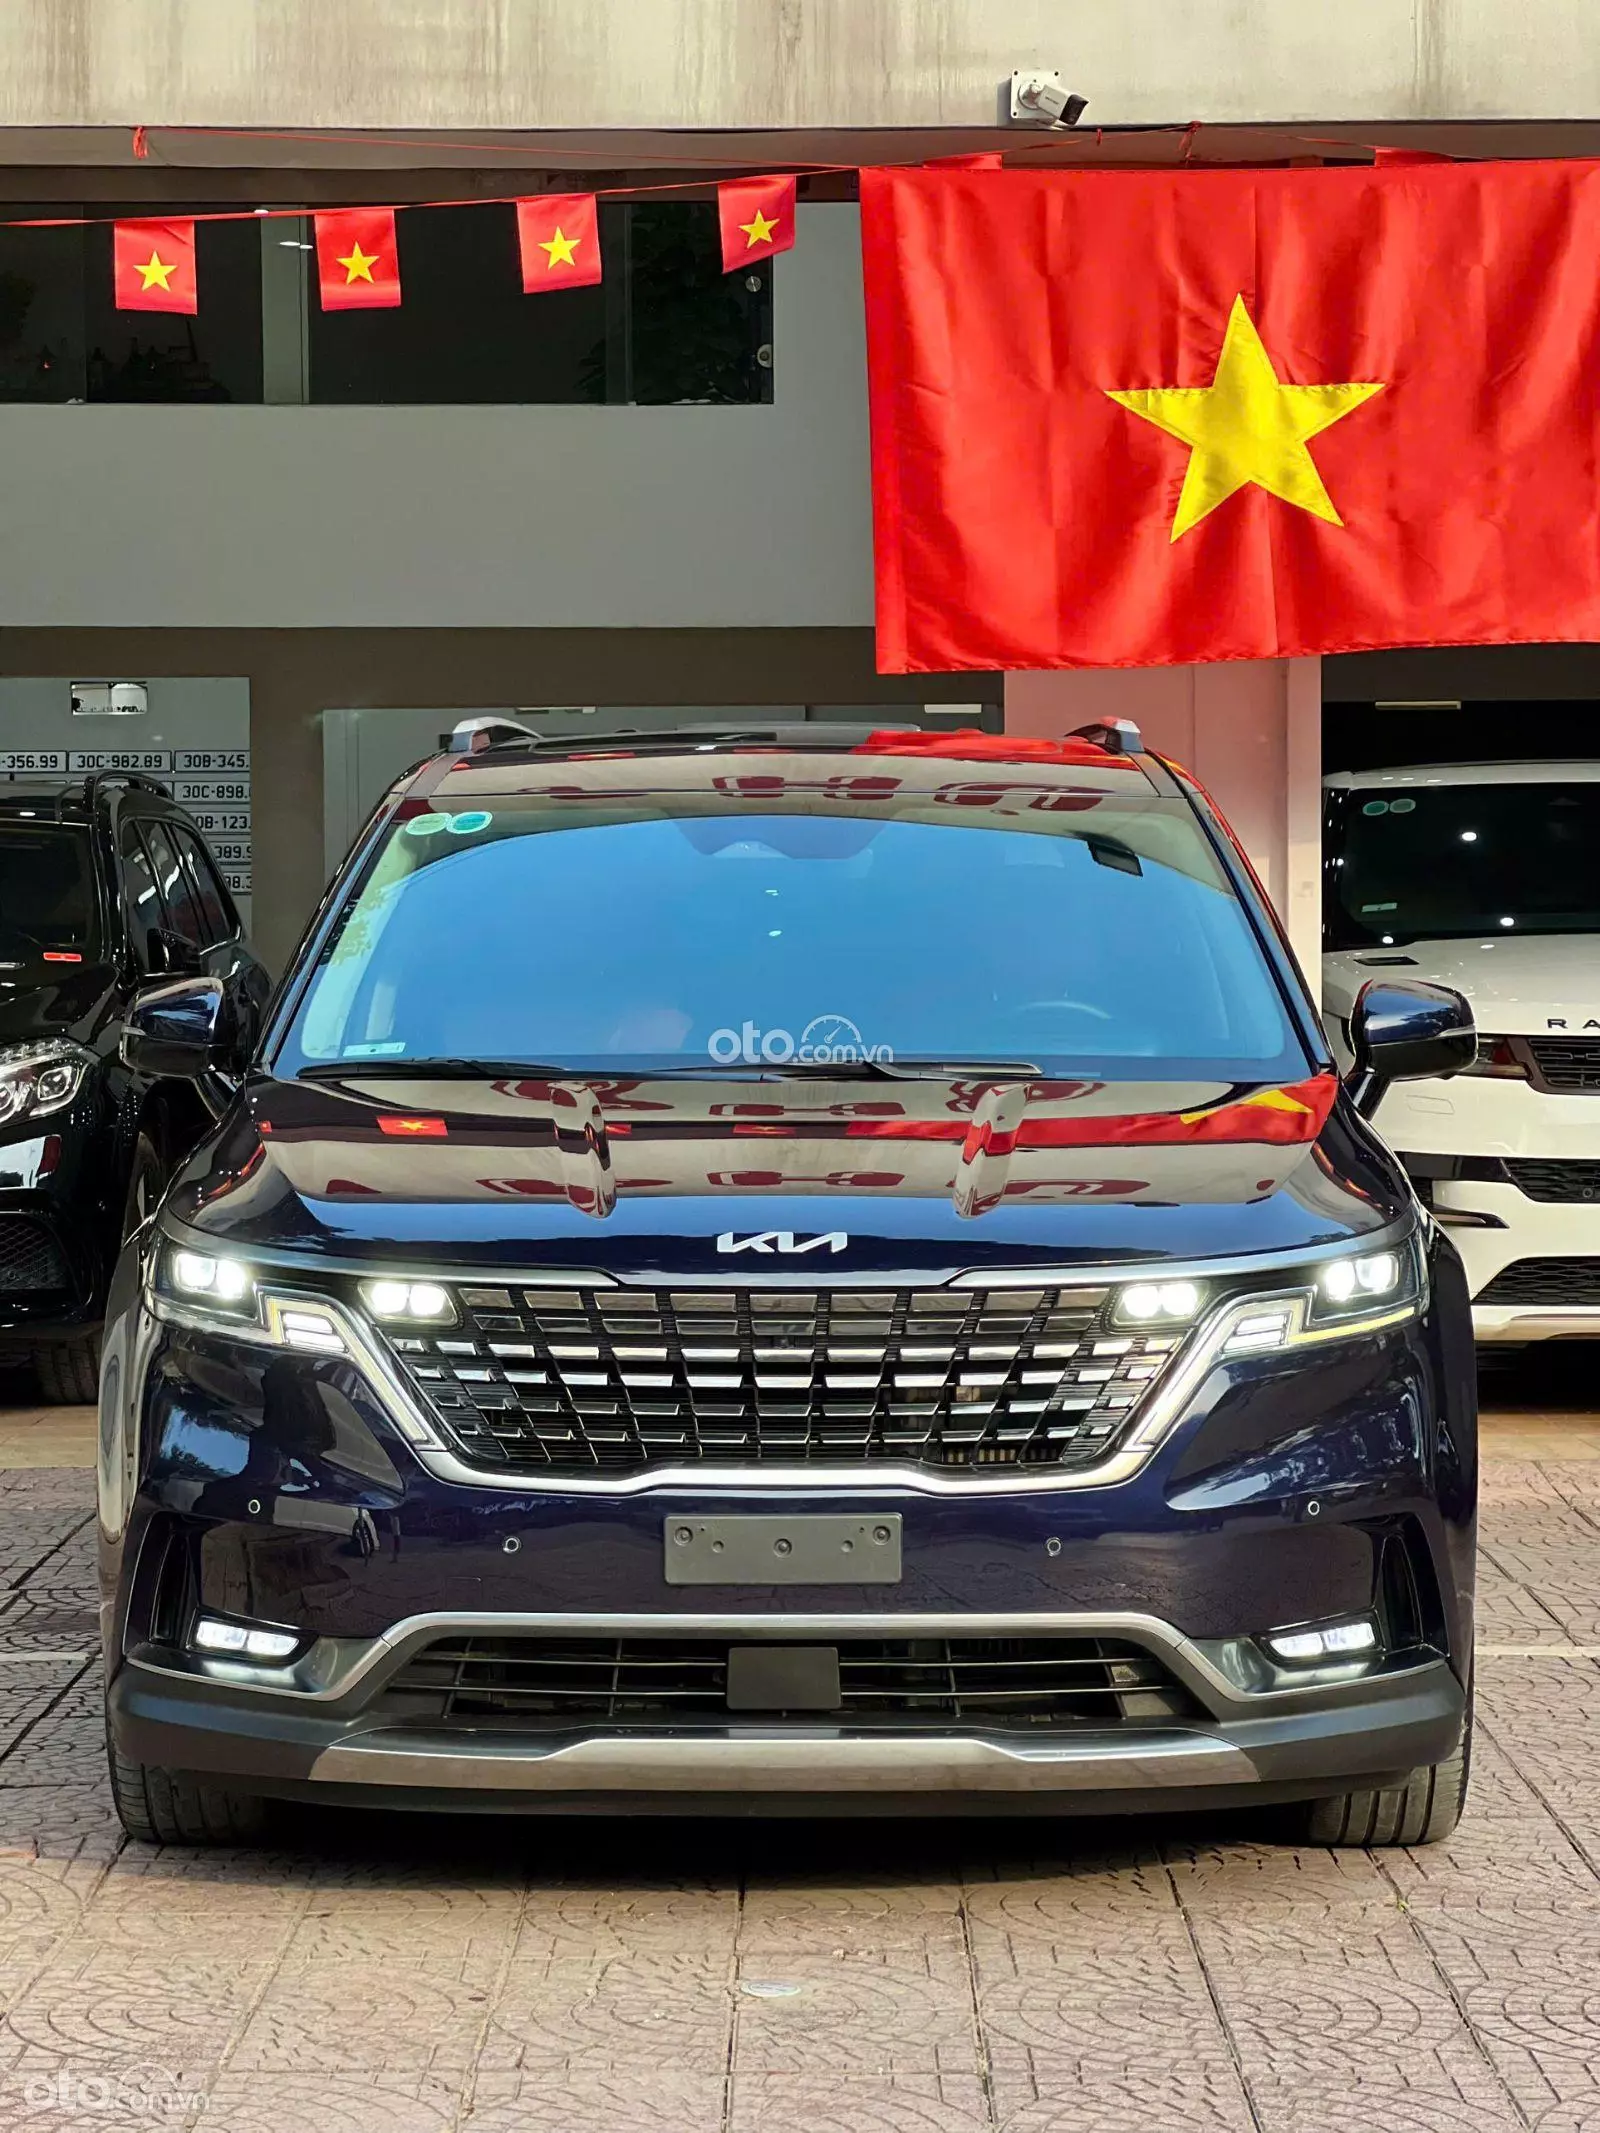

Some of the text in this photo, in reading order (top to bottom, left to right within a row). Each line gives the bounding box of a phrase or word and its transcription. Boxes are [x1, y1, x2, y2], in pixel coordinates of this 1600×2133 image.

[77, 755, 163, 768] 30C-982.89
[182, 785, 250, 799] 30C-898.
[717, 1231, 848, 1253] KIA
